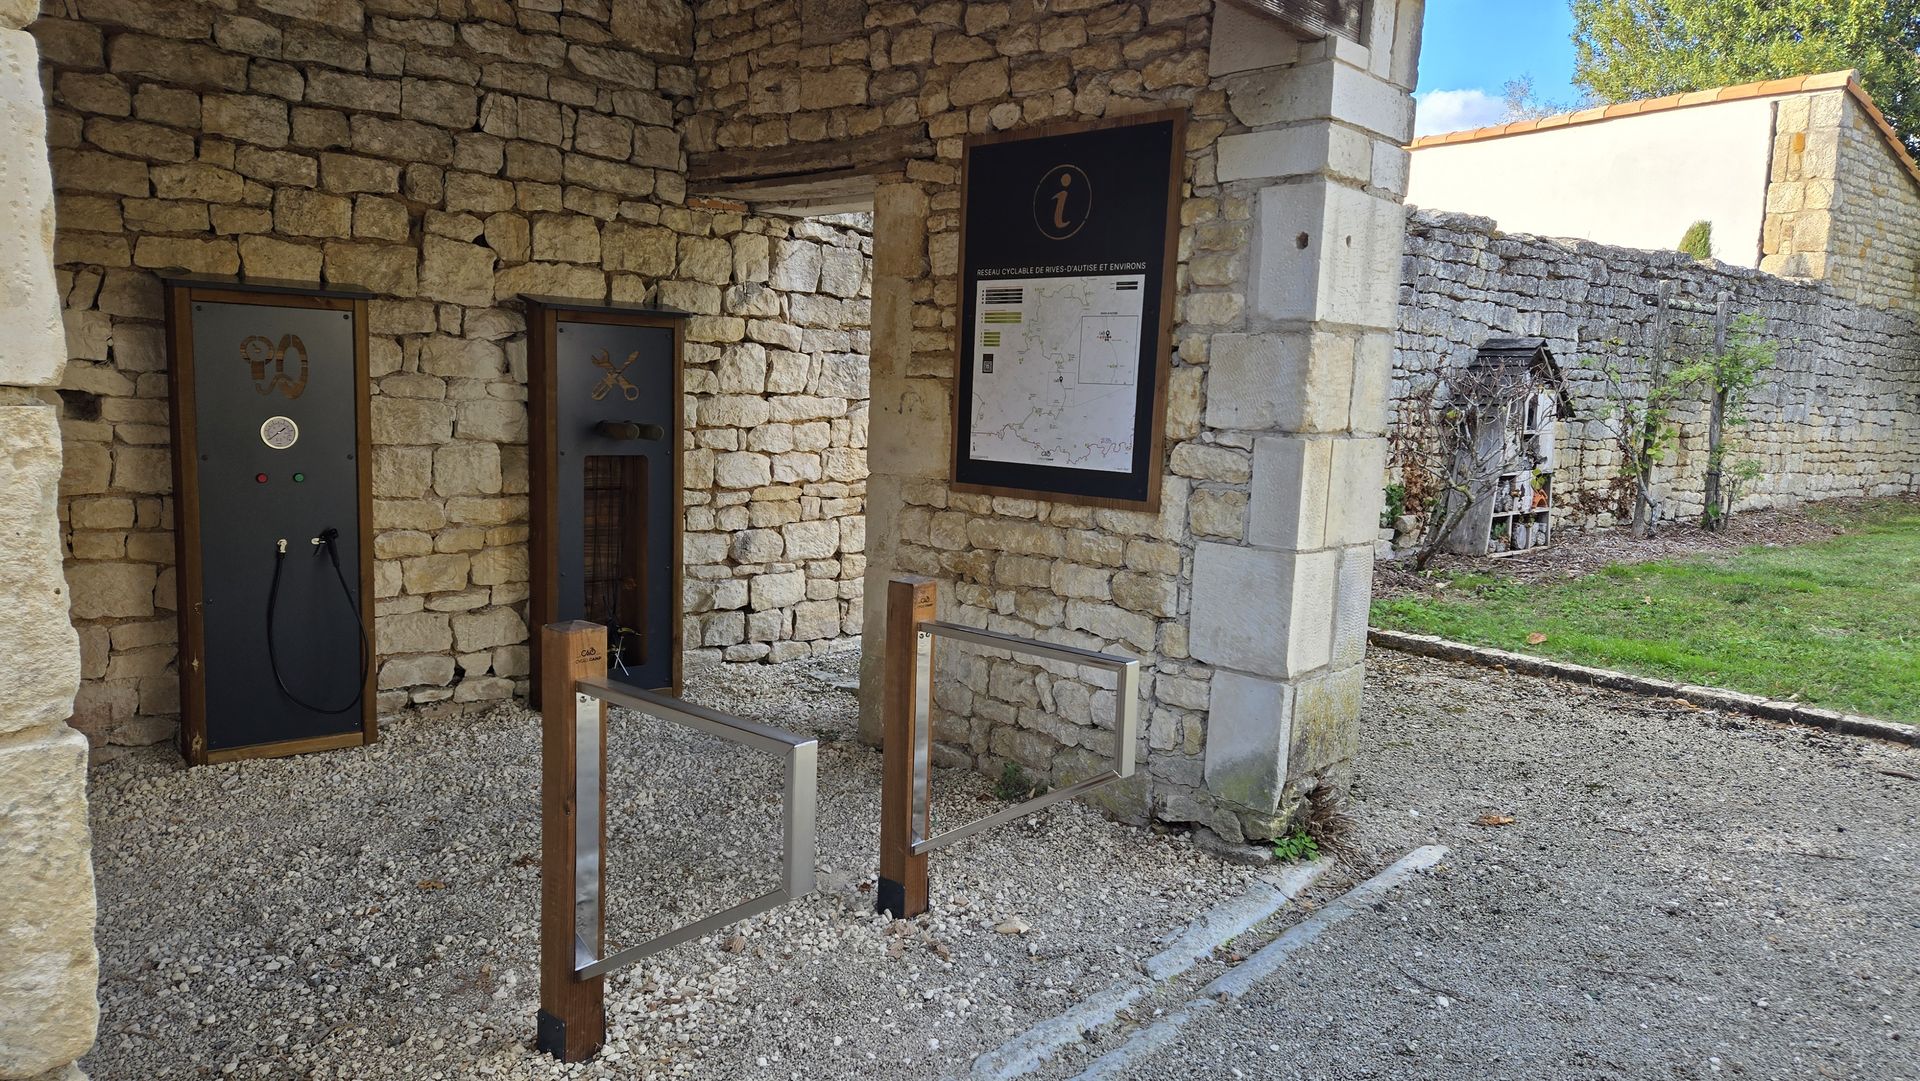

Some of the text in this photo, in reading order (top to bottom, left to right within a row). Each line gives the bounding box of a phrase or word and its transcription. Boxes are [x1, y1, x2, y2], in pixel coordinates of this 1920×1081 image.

[1001, 266, 1034, 275] CYCLABLE
[1036, 266, 1044, 274] DE
[1099, 263, 1108, 271] ET
[1110, 261, 1146, 271] ENVIRONS
